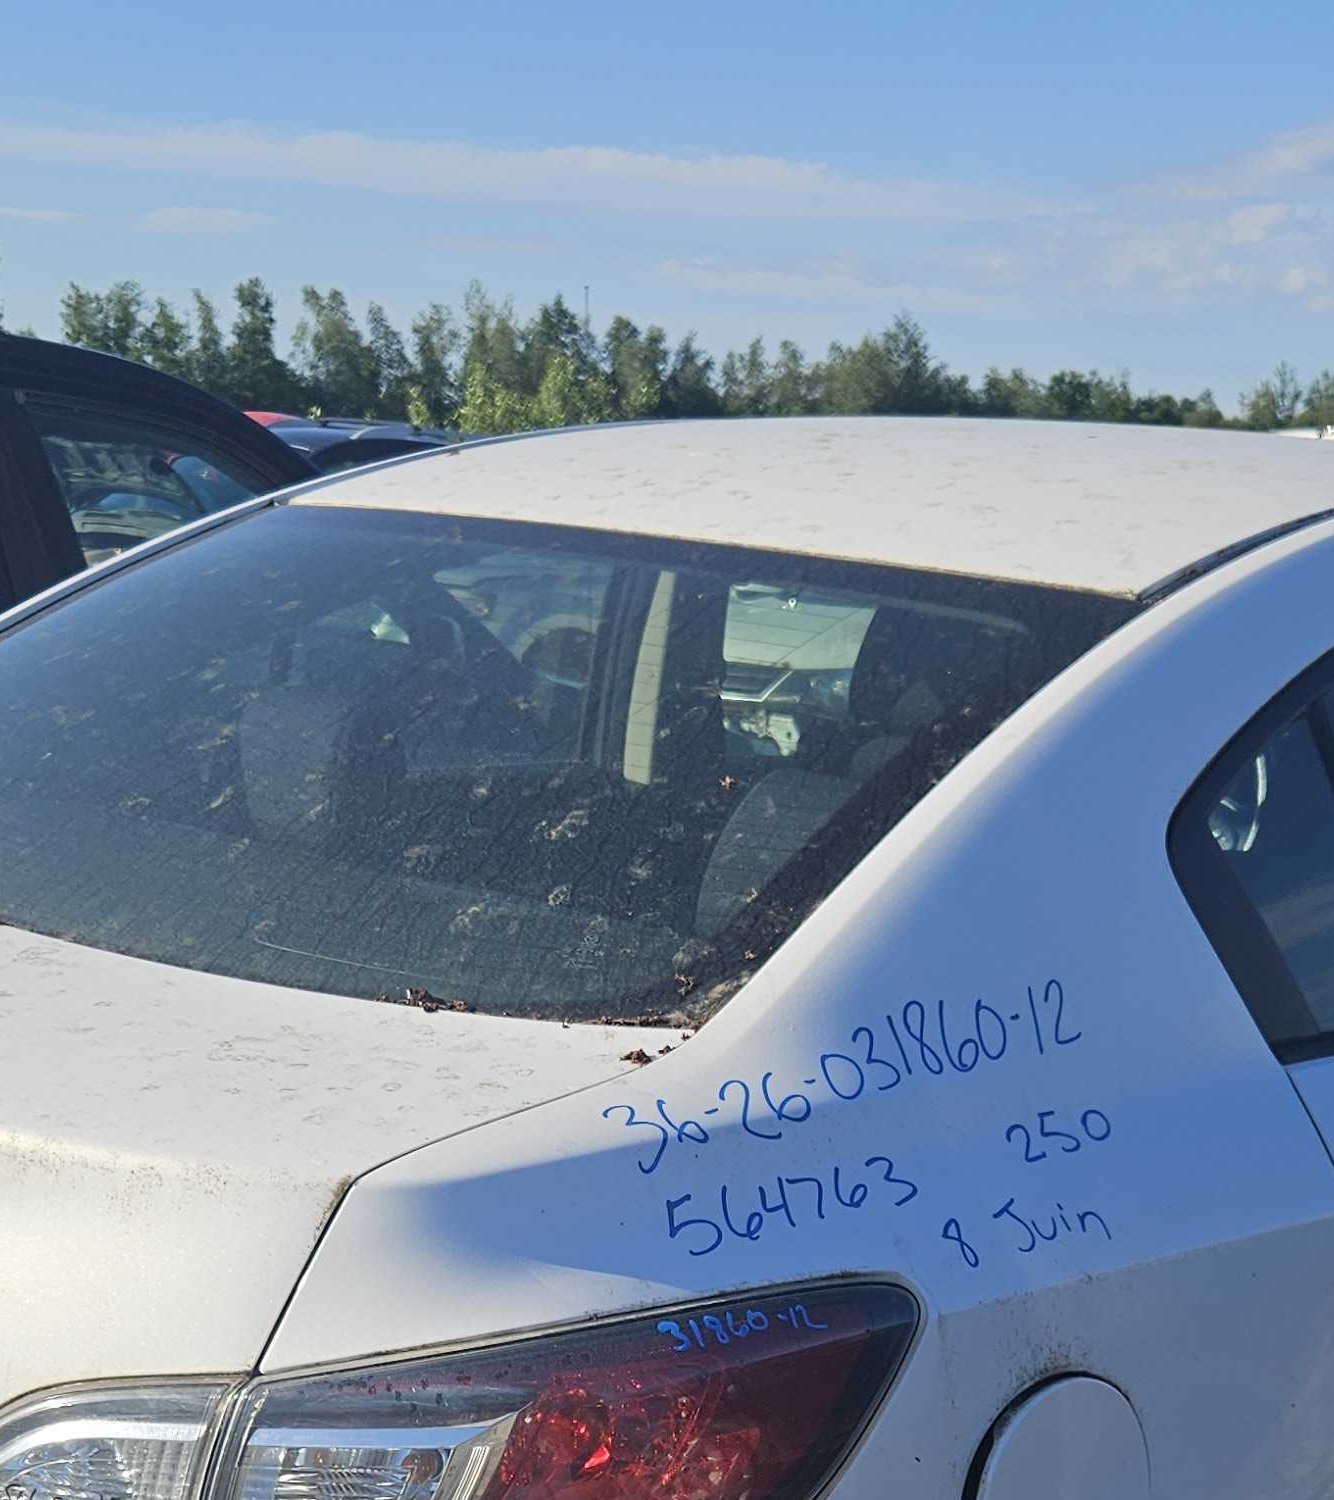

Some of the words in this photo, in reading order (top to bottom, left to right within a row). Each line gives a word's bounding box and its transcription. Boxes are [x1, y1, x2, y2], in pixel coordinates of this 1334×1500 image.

[602, 979, 1082, 1174] 36-26-031860-12
[1005, 1108, 1111, 1163] 250
[667, 1156, 918, 1256] 564763
[942, 1217, 979, 1268] 8
[993, 1198, 1111, 1253] Juin
[657, 1304, 828, 1351] 31860-12
